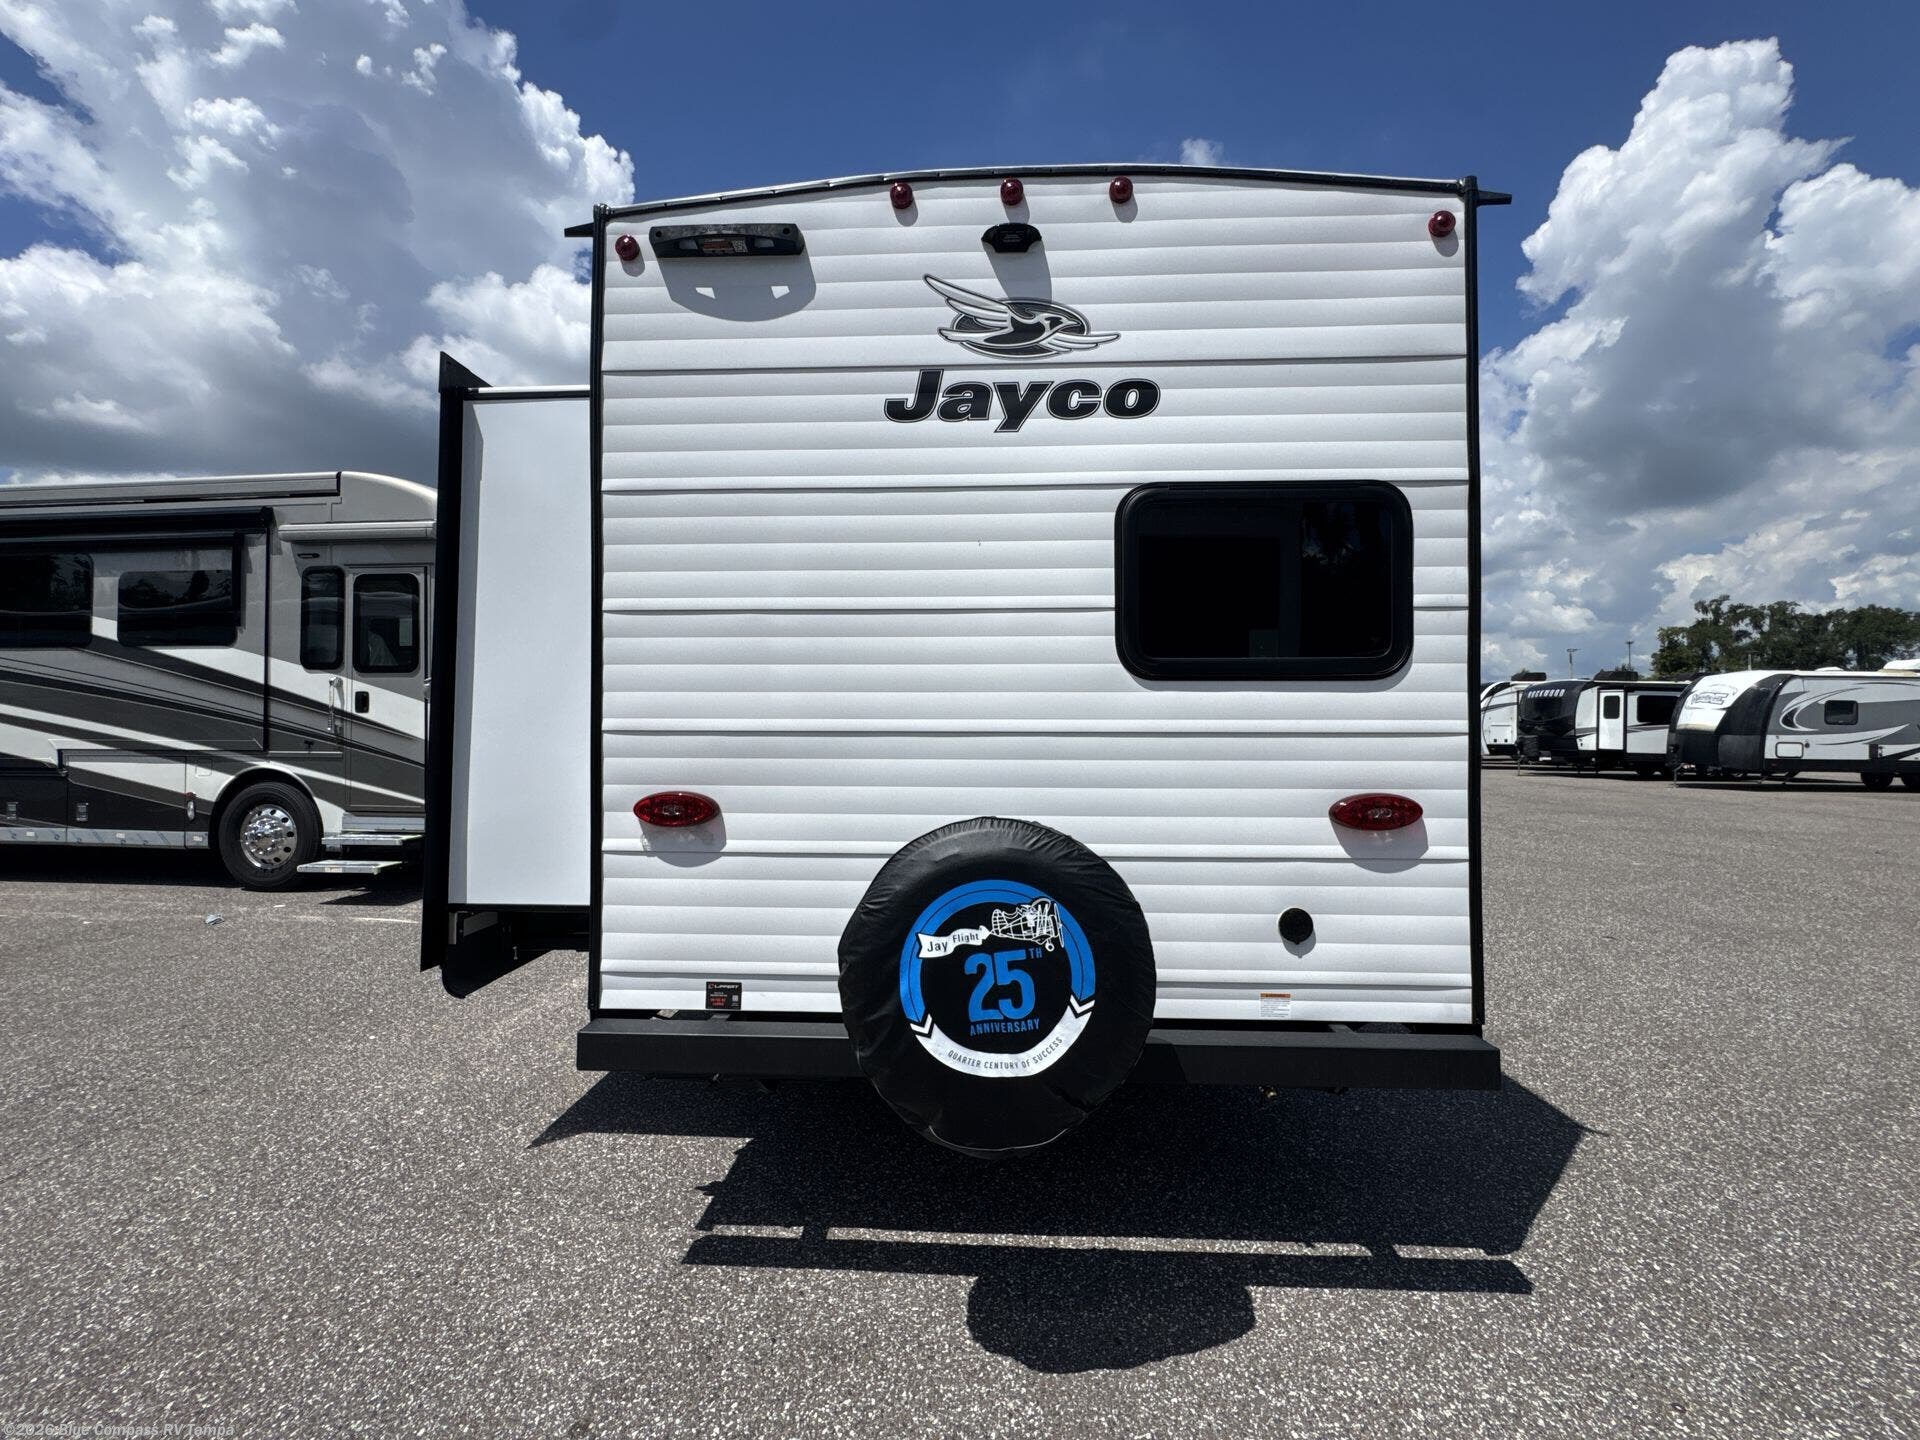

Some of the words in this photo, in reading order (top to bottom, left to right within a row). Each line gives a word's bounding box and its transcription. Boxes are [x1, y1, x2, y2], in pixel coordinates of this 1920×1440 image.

[884, 368, 1161, 433] Jayco
[927, 940, 948, 953] Jay
[952, 932, 979, 944] Flight
[970, 1018, 1040, 1036] ANNIVERSARY
[948, 1050, 981, 1068] QUARTER
[984, 1061, 1019, 1070] CENTURY
[1022, 1059, 1032, 1069] OF
[1033, 1036, 1063, 1064] SUCCESS
